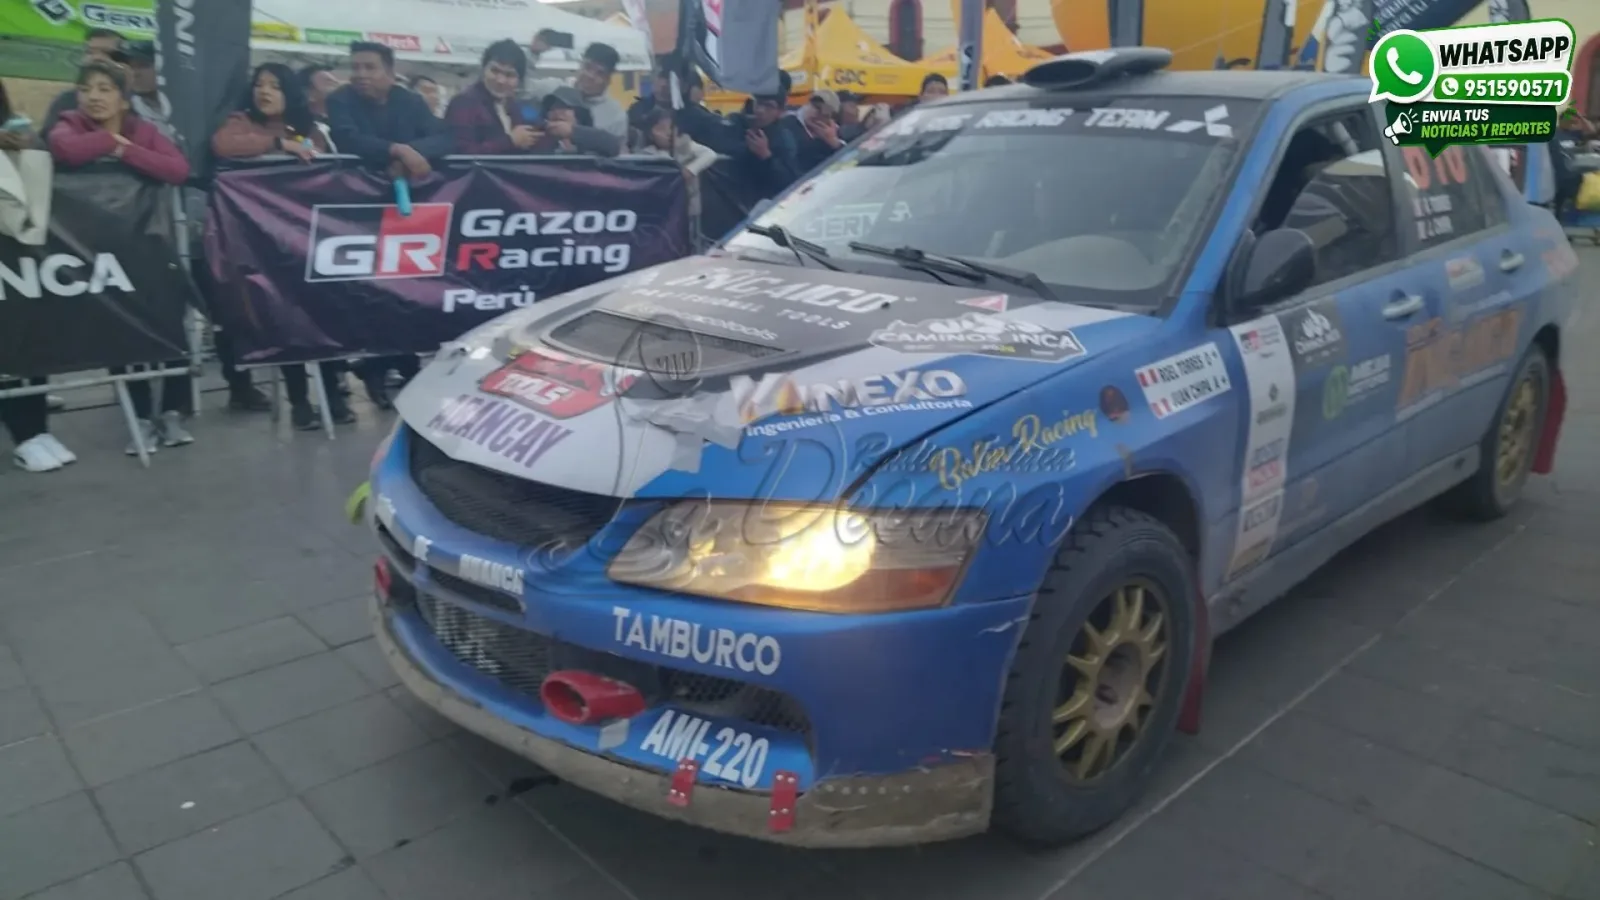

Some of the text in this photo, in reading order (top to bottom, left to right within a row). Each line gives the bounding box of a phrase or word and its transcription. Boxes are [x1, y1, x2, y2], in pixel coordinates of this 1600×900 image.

[1083, 107, 1171, 130] TEAM
[314, 233, 442, 276] GR
[456, 239, 630, 272] Racing
[879, 331, 1001, 343] CAMINOS
[1012, 333, 1079, 350] INCA
[1013, 408, 1098, 453] Racing
[613, 606, 782, 676] TAMBURCO
